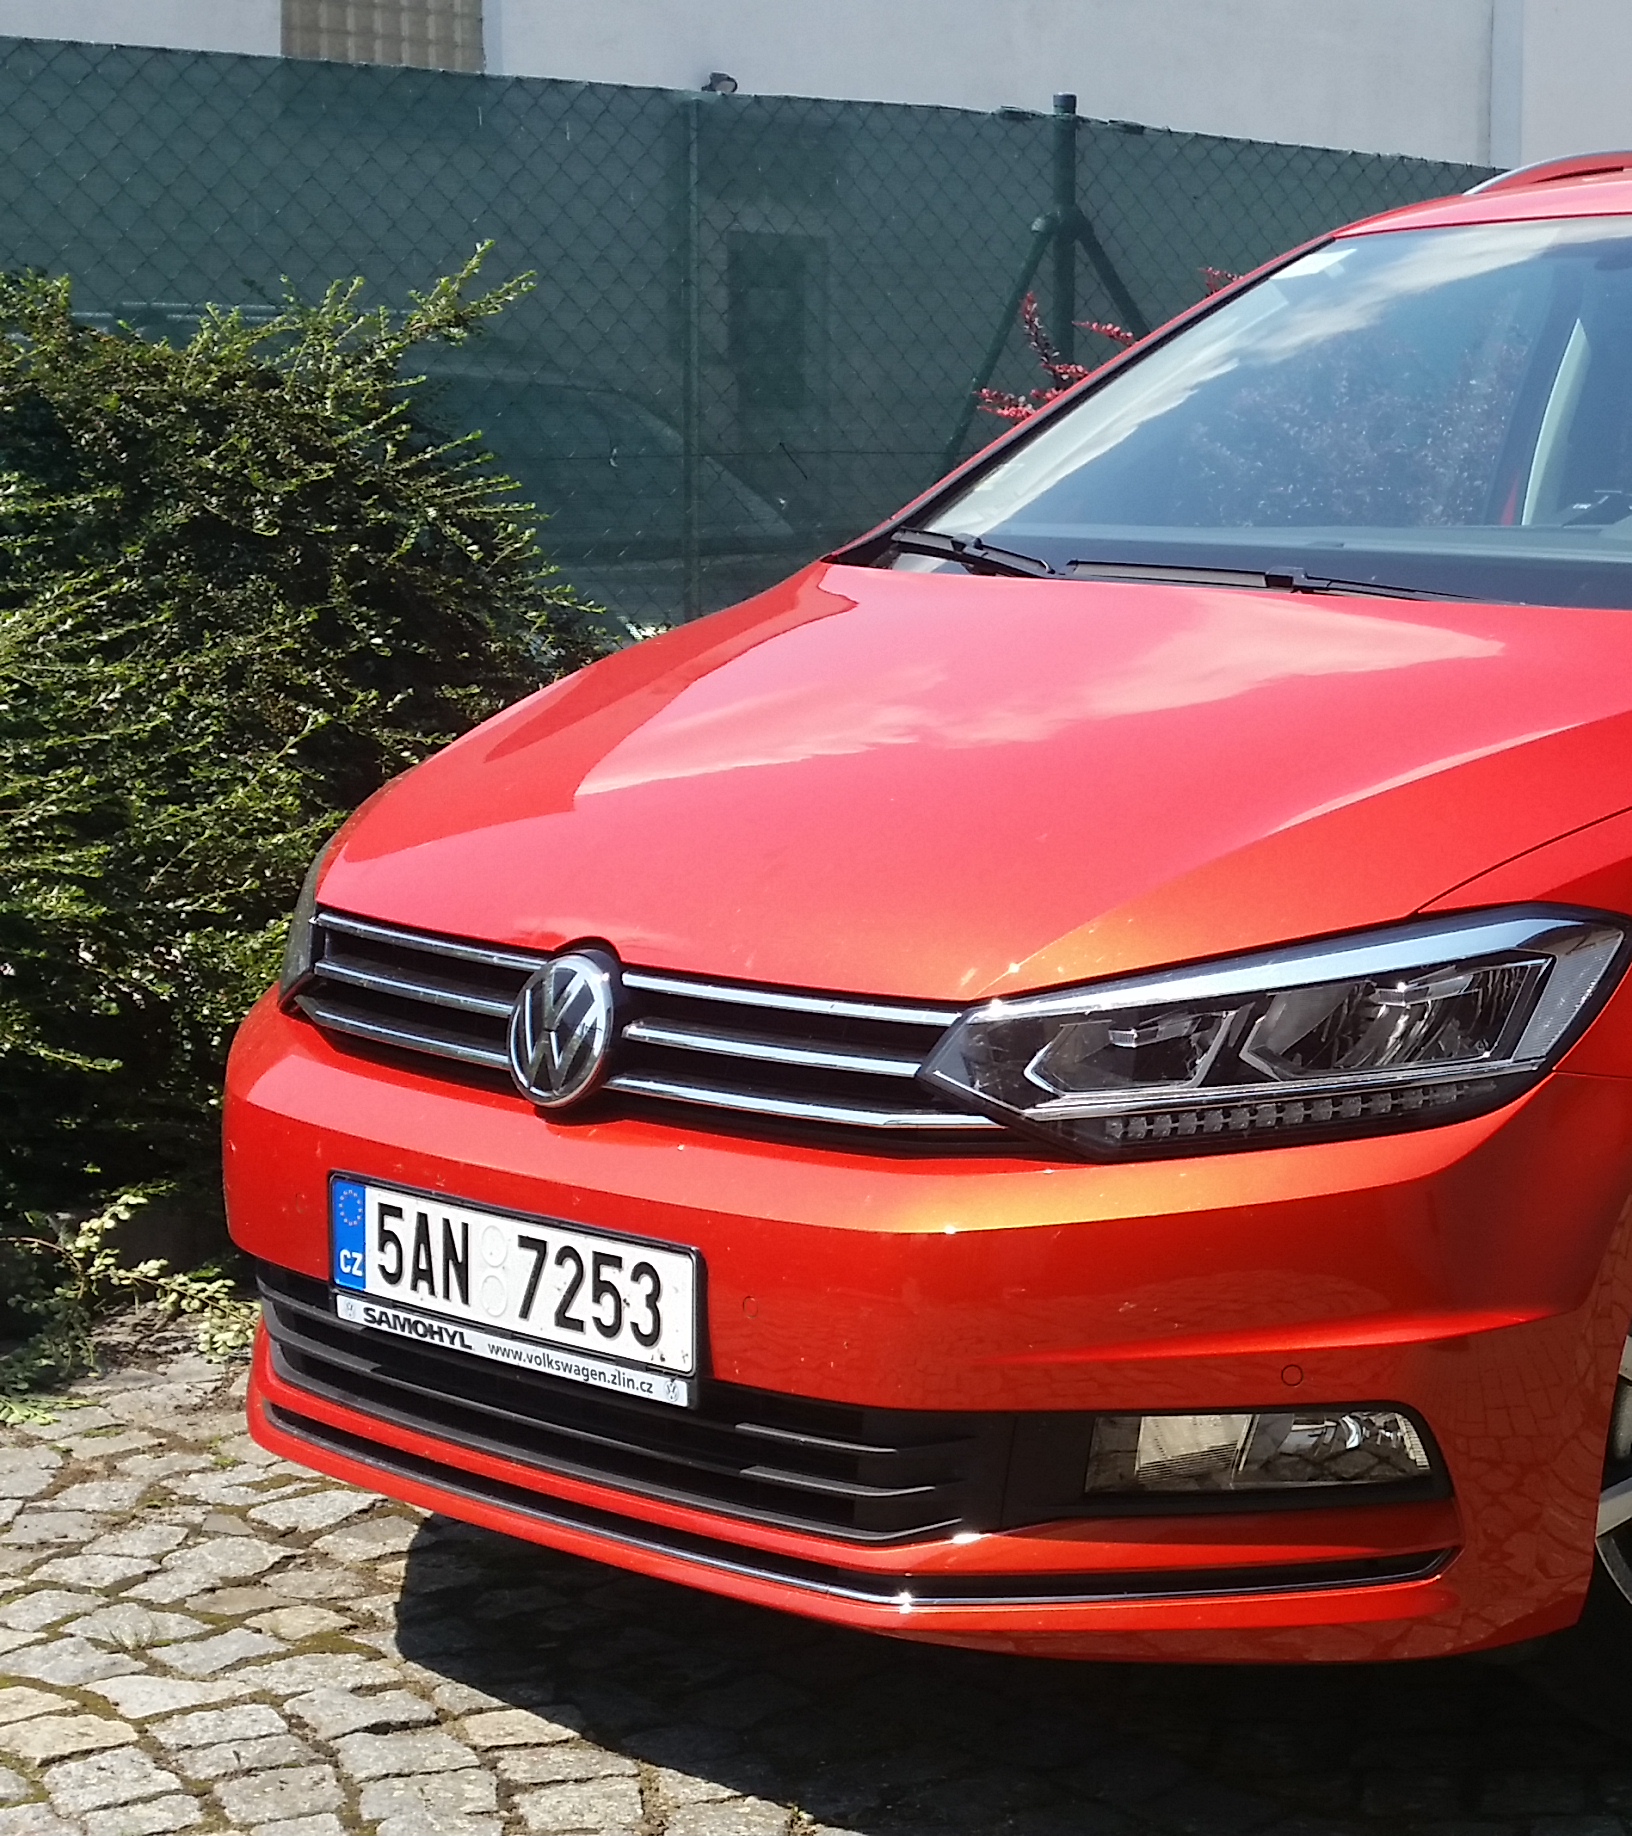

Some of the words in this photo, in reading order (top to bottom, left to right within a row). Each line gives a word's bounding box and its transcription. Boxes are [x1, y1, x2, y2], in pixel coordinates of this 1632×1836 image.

[339, 1248, 364, 1278] CZ
[376, 1202, 471, 1308] 5AN
[517, 1234, 662, 1349] 7253
[363, 1306, 473, 1351] SAMOHYL
[487, 1341, 654, 1395] www.volkswagen.zlin.cz
